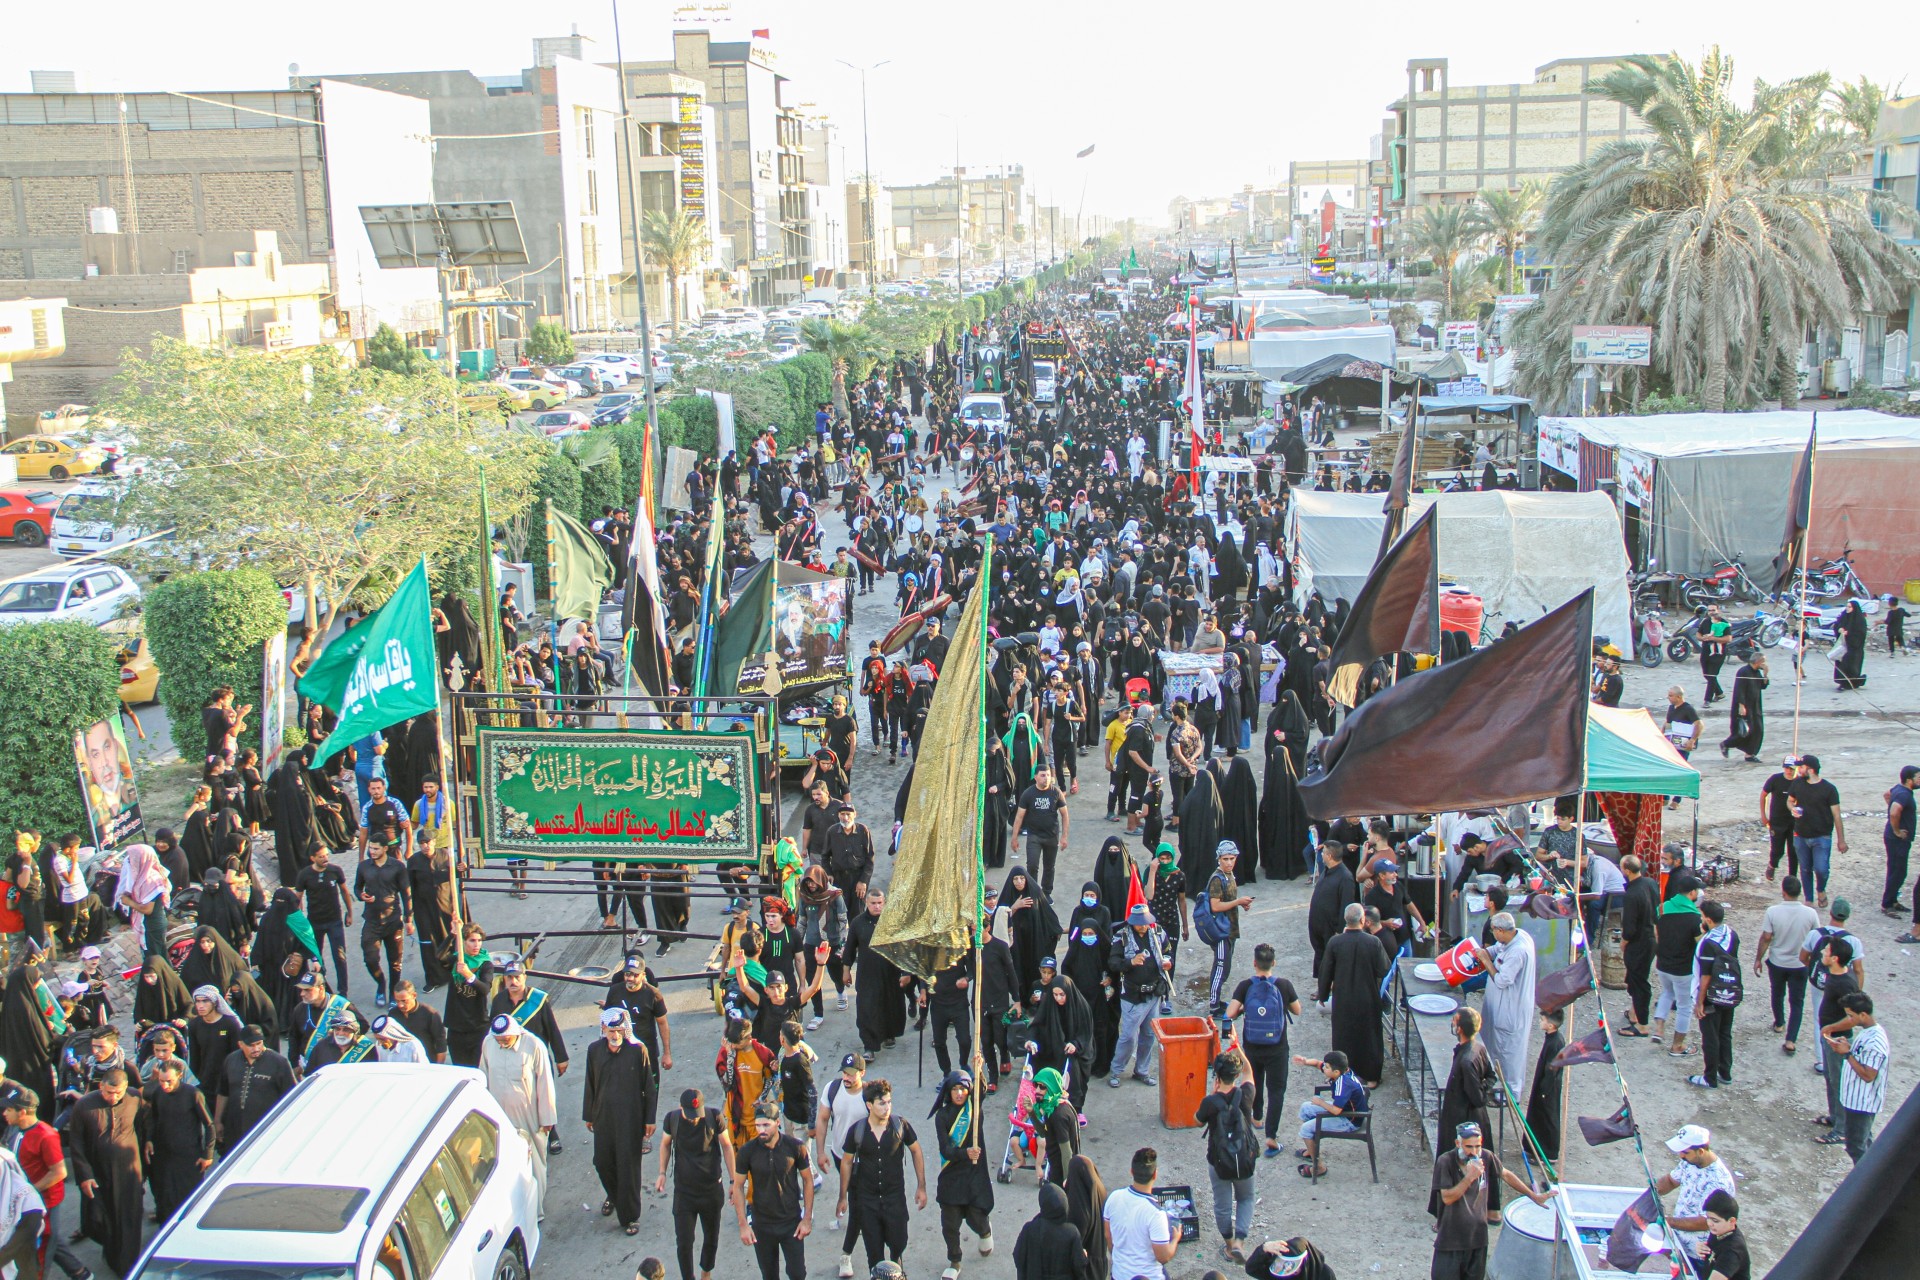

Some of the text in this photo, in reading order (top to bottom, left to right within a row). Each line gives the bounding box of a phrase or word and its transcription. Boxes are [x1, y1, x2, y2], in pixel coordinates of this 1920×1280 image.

[532, 751, 703, 800] المسيرة الحسينية الخالدة
[582, 808, 625, 835] القاسم
[626, 807, 658, 842] مدينة
